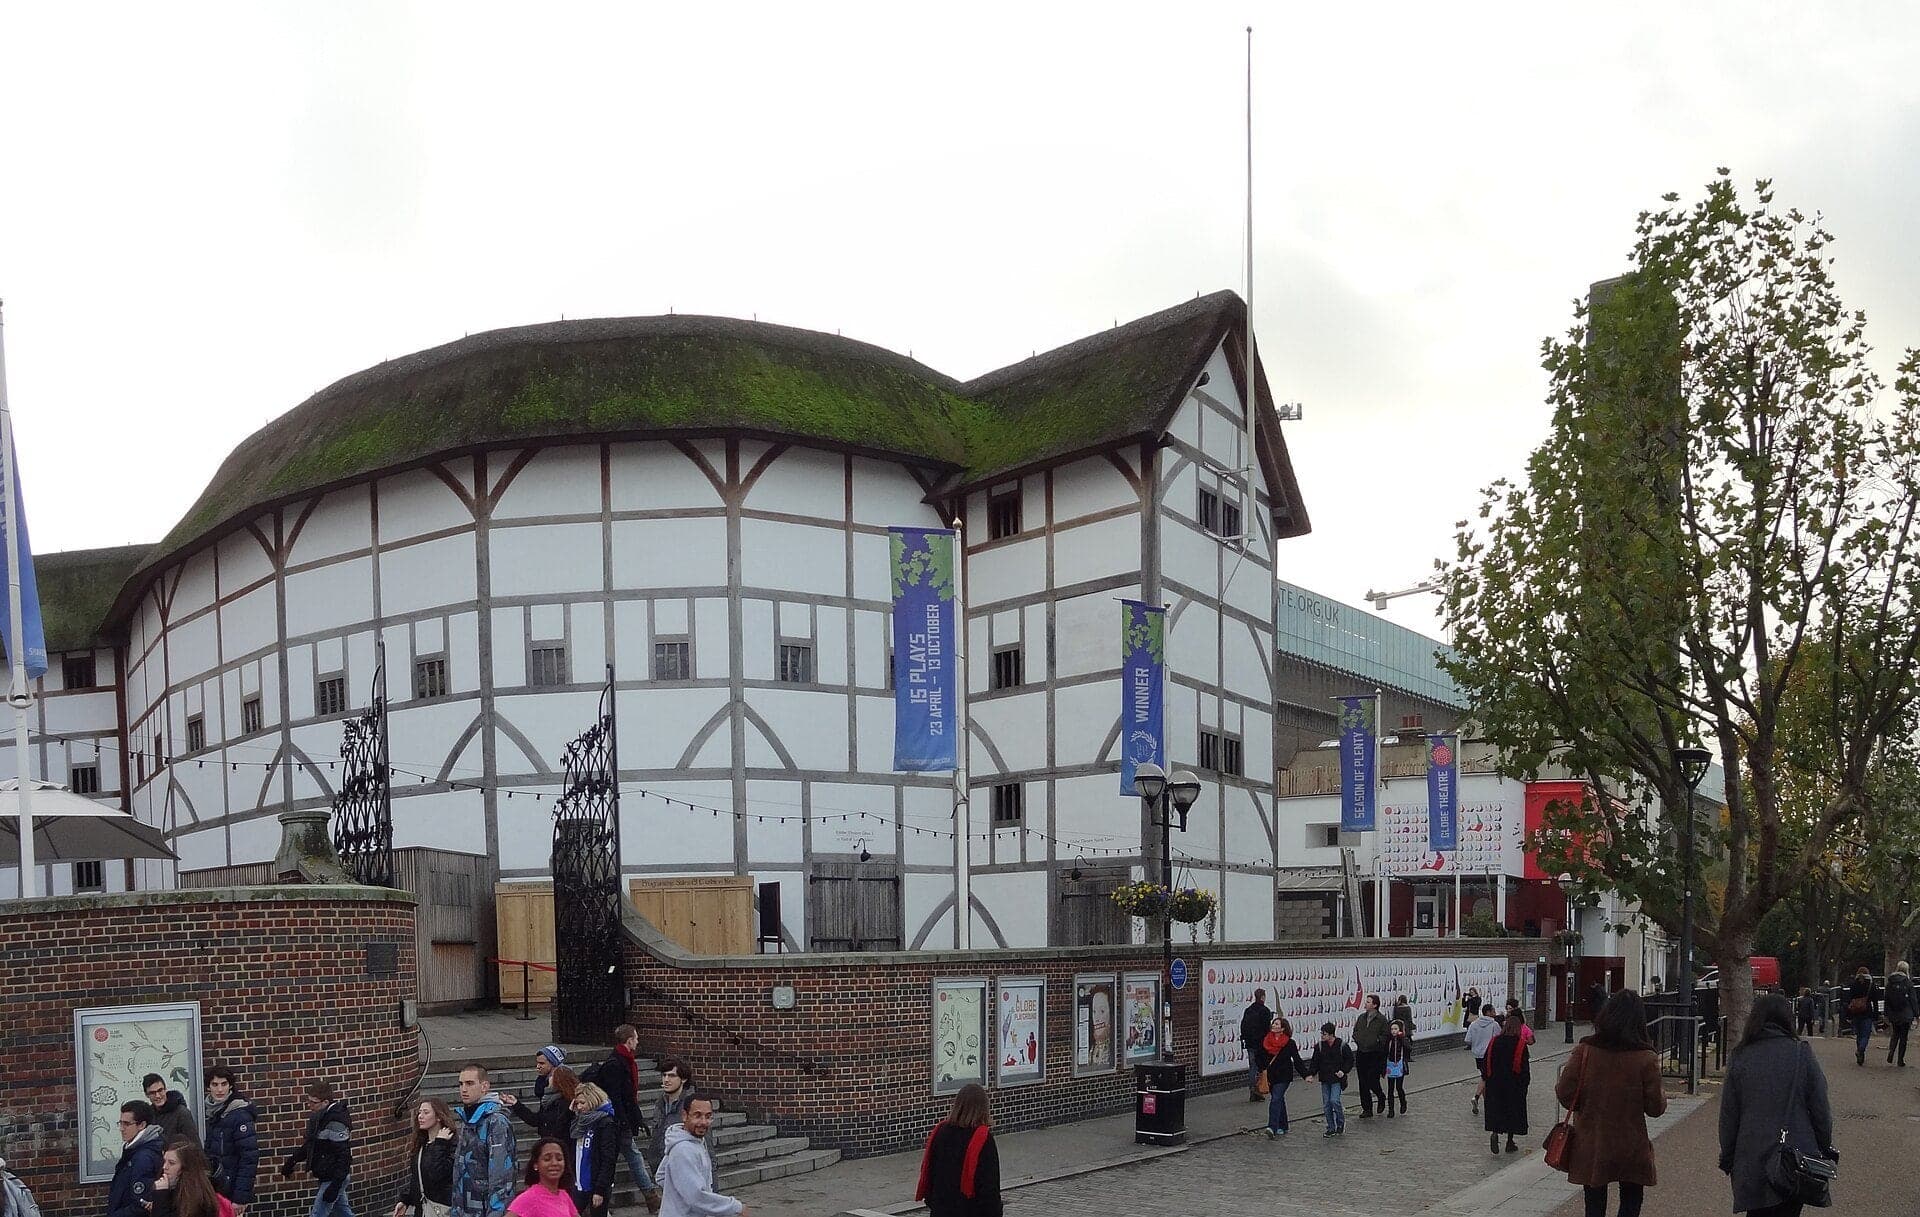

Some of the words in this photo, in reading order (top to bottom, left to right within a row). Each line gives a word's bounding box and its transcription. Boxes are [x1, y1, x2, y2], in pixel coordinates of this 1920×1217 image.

[926, 604, 940, 655] OCTOBER
[910, 633, 926, 683] PLAYS
[928, 658, 940, 670] 13
[911, 688, 927, 704] 15
[930, 687, 942, 718] APRIL
[1135, 667, 1149, 723] WINNER
[931, 720, 942, 735] 23
[1353, 731, 1364, 768] PLENTY
[1354, 769, 1364, 781] OF
[1437, 770, 1449, 807] THEATRE
[1354, 783, 1365, 819] SEASON
[1440, 810, 1450, 838] GLOBE
[1015, 1000, 1037, 1012] GLOBE
